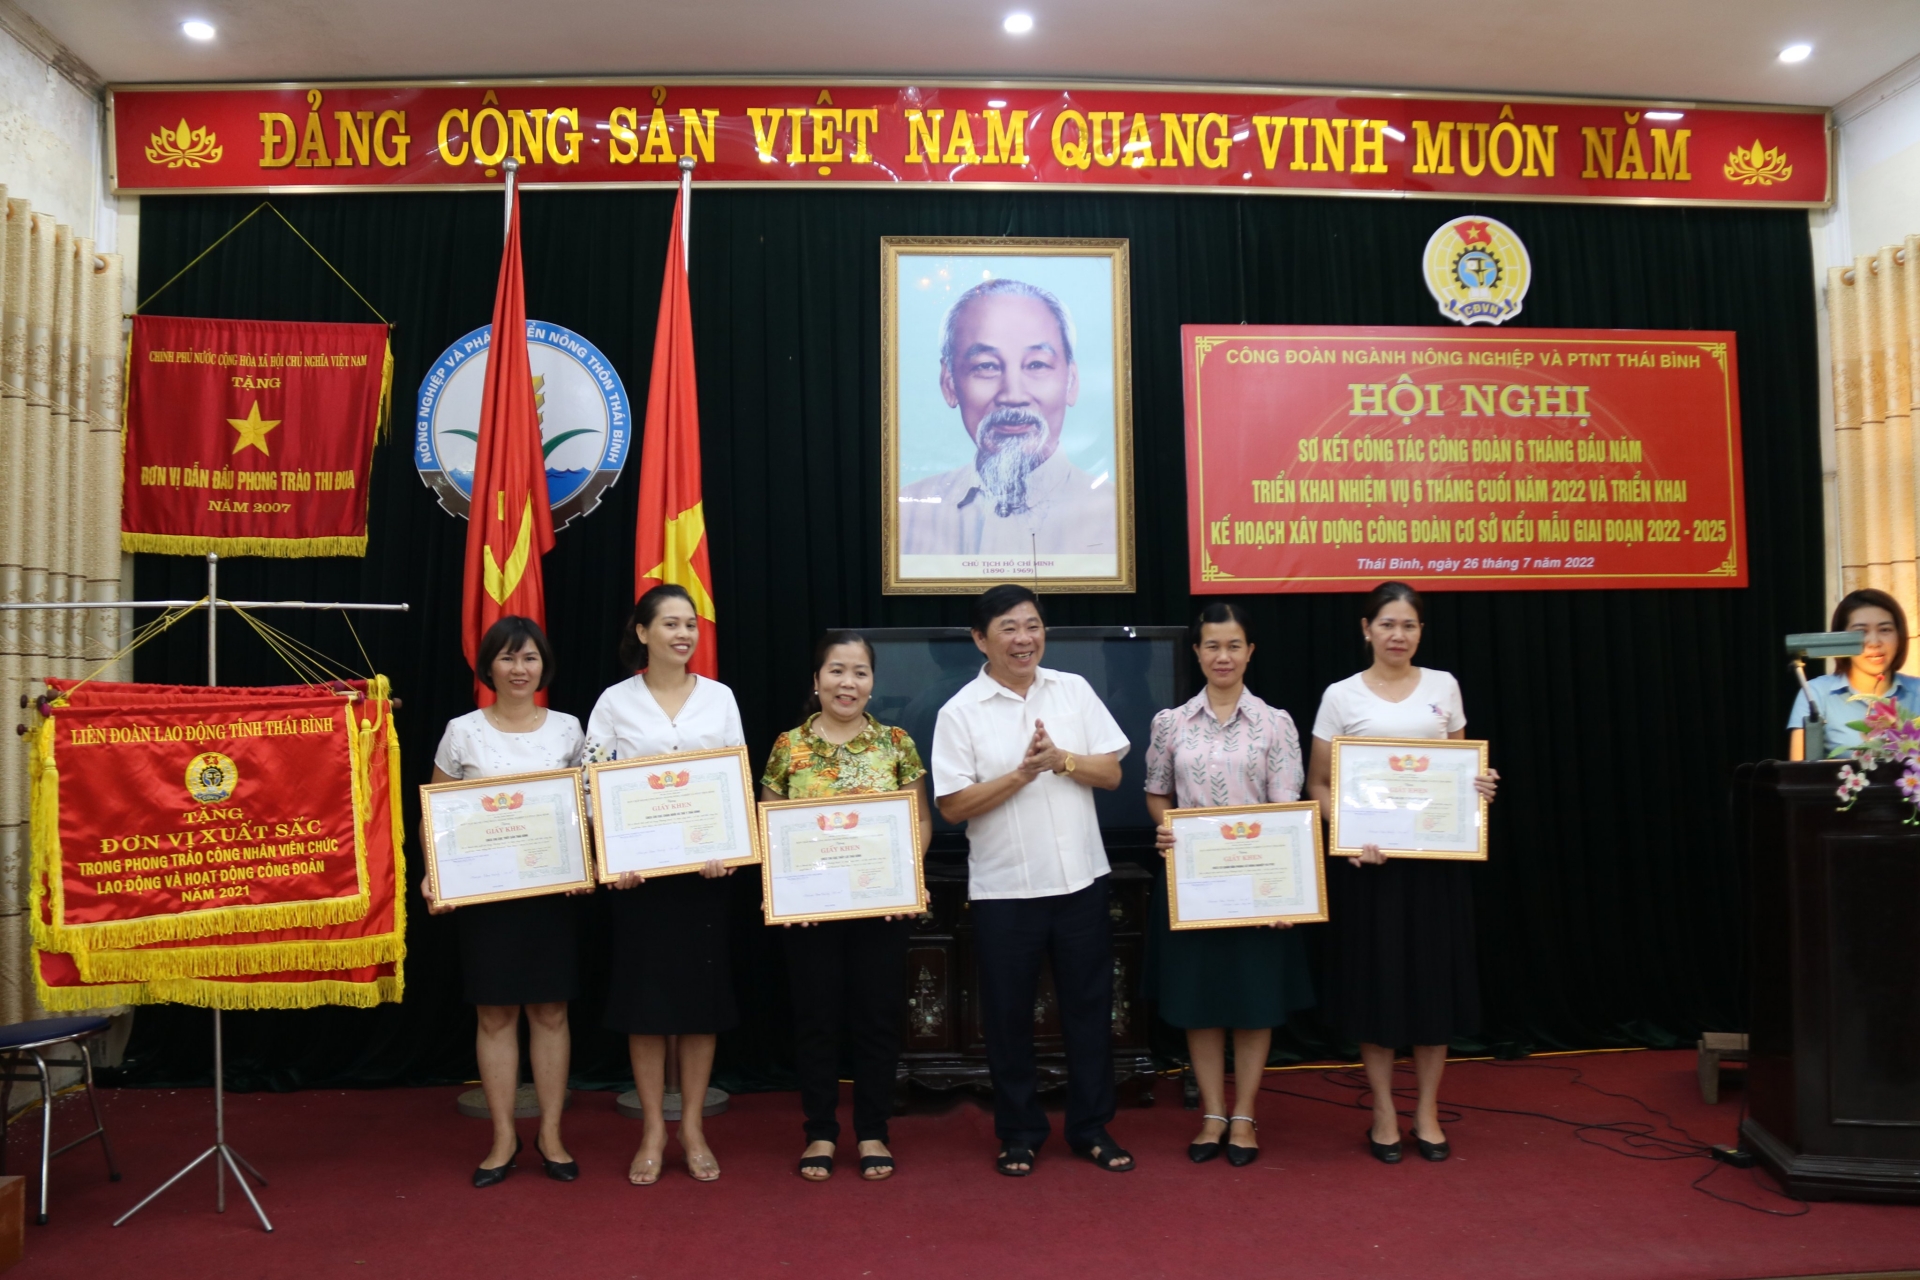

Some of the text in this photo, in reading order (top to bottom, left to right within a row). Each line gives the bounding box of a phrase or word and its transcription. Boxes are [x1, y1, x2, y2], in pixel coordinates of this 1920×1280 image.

[259, 85, 1692, 181] ĐẢNG CỘNG SẢN VIỆT NAM QUANG VINH MUÔN NĂM
[464, 330, 491, 353] PHÁ
[549, 331, 587, 358] NÔNG
[149, 347, 368, 370] CHÍNH PHỦ NƯỚC CỘNG HÒA XÃ HỘI CHỦ NGHĨA VIỆT NAM
[444, 348, 465, 368] VÀ
[1226, 346, 1701, 369] CÔNG ĐOÀN NGÀNH NÔNG NGHIỆP VÀ PTNT THÁI BÌNH
[231, 375, 282, 391] TẶNG
[588, 355, 615, 391] THÔN
[419, 367, 445, 418] NGHIỆP
[1347, 373, 1592, 427] HỘI NGHỊ
[609, 392, 626, 425] THÁI
[416, 420, 433, 464] NÔNG
[607, 431, 624, 464] BÌNH
[1298, 431, 1642, 463] SƠ KẾT CÔNG TÁC CÔNG ĐOÀN 6 THÁNG ĐẦU NĂM
[141, 461, 355, 491] ĐƠN VỊ DẪN ĐẦU PHONG TRÀO THI ĐUA
[1252, 470, 1687, 508] TRIỂN KHAI NHIỆM VỤ 6 THÁNG CUỐI NĂM 2022 VÀ TRIỂN KHAI
[207, 498, 291, 513] NĂM 2007
[1211, 513, 1231, 545] KẾ
[1234, 521, 1285, 550] HOẠCH
[1289, 516, 1318, 544] XÂY
[1322, 520, 1363, 549] DỰNG
[1367, 515, 1407, 544] CÔNG
[1411, 515, 1451, 544] ĐOÀN
[1455, 518, 1475, 543] CƠ
[1479, 512, 1499, 543] SỞ
[1502, 510, 1534, 543] KIỂU
[1538, 510, 1570, 543] MẪU
[1573, 519, 1602, 543] GIAI
[1605, 519, 1644, 547] ĐOẠN
[1647, 519, 1681, 542] 2022
[1693, 519, 1727, 542] 2025
[1357, 558, 1595, 572] Thái Bình, ngày 26 tháng 7 năm 2022
[70, 716, 333, 745] LIÊN ĐOÀN LAO ĐỘNG TỈNH THÁI BÌNH
[183, 807, 244, 824] TẶNG
[652, 803, 670, 812] GIẤY
[100, 817, 322, 854] ĐƠN VỊ XUẤT SẮC
[486, 826, 504, 835] GIẤY
[78, 837, 339, 877] TRONG PHONG TRÀO CÔNG NHÂN VIÊN CHỨC
[820, 845, 838, 854] GIẤY
[97, 858, 325, 896] LAO ĐỘNG VÀ HOẠT ĐỘNG CÔNG ĐOÀN
[181, 885, 250, 903] NĂM 2021
